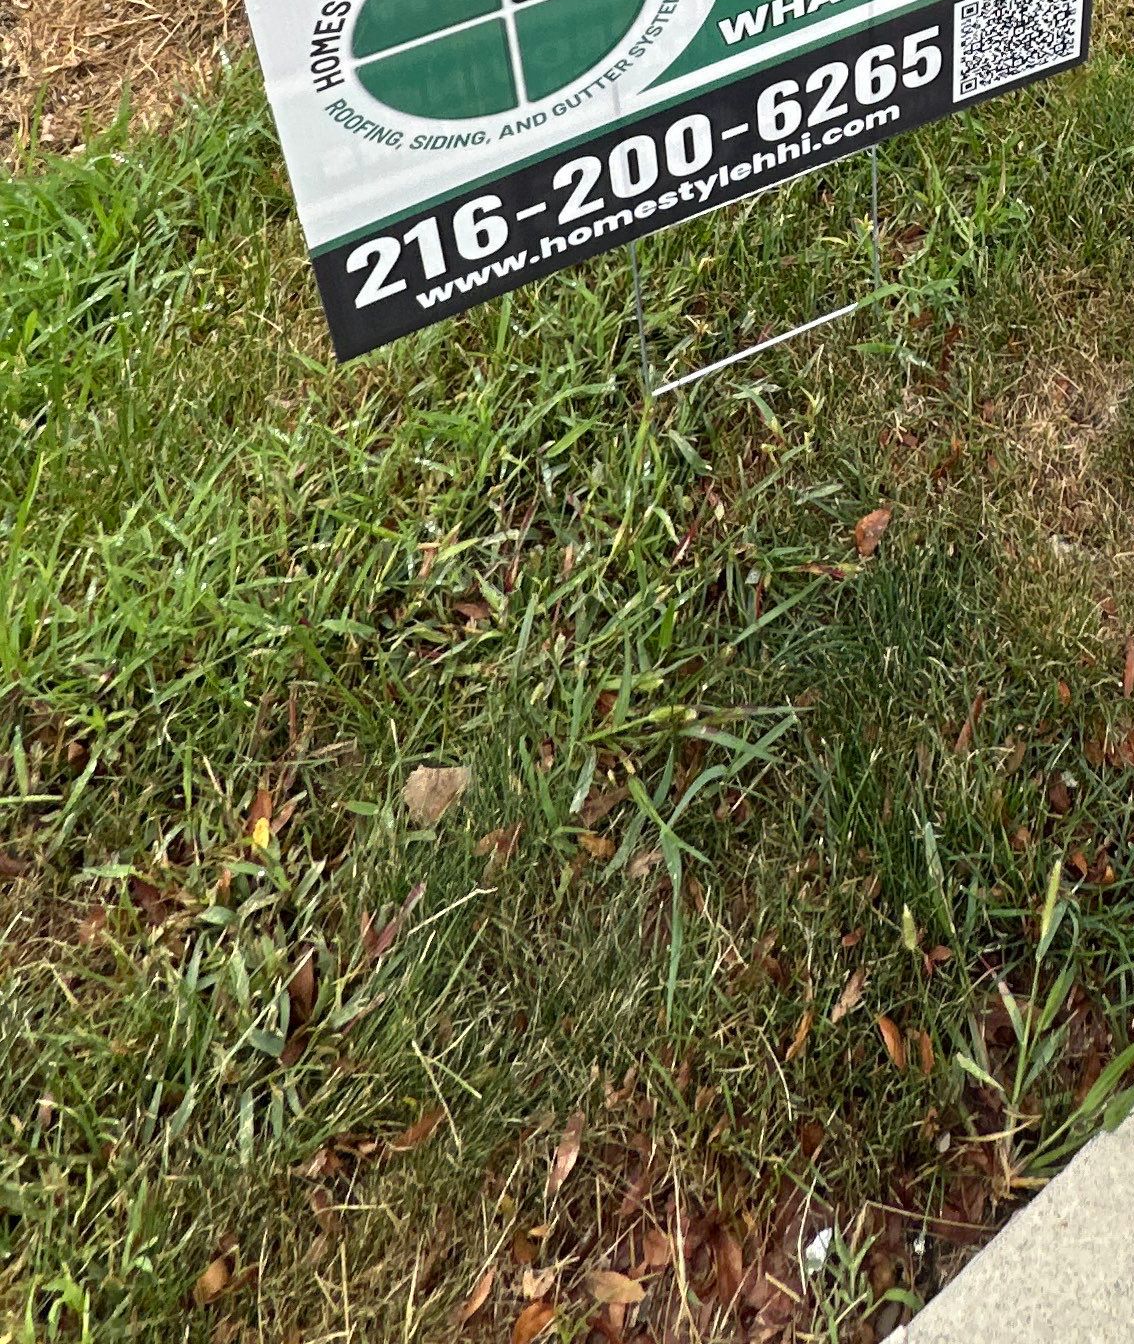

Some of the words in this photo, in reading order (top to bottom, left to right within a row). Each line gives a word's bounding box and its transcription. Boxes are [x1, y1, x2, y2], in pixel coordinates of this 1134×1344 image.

[324, 98, 404, 150] ROOFING,
[409, 131, 490, 151] SIDING,
[498, 111, 547, 140] AND
[552, 58, 633, 117] GUTTER
[345, 25, 943, 311] 216-200-6265
[415, 105, 900, 309] www.homestylehhi.com
